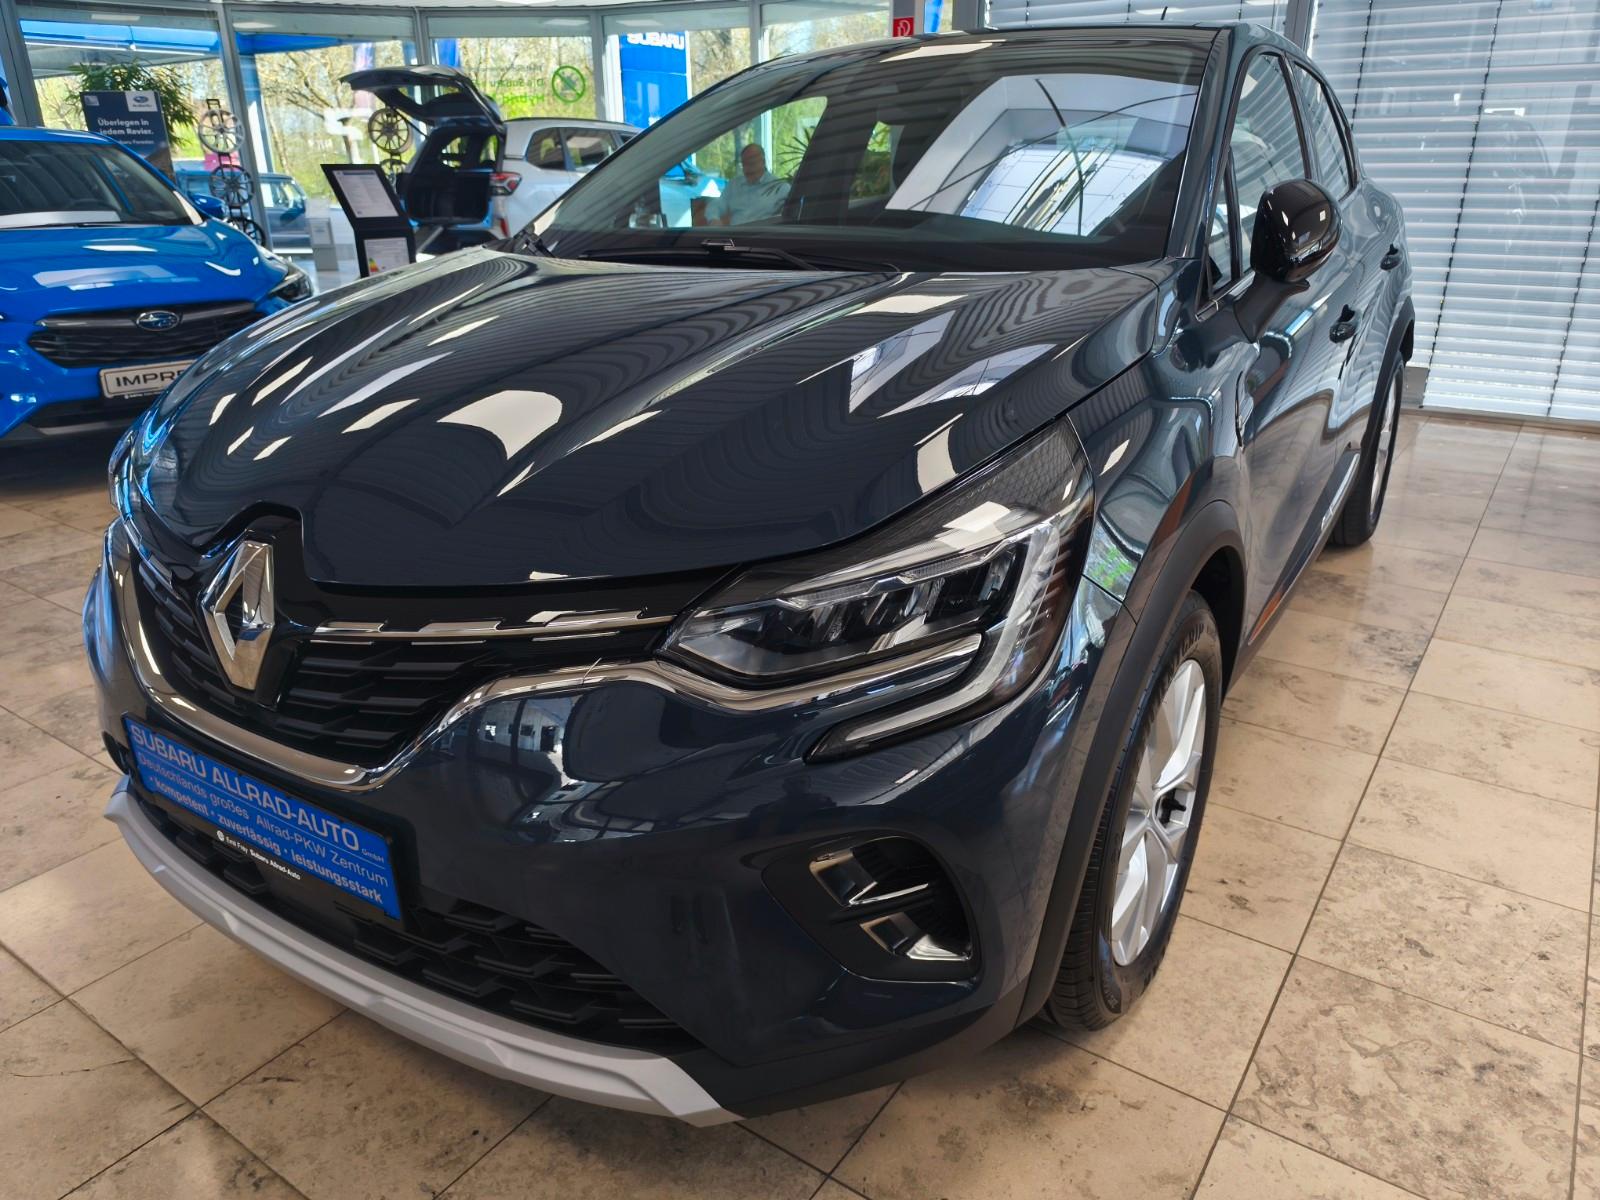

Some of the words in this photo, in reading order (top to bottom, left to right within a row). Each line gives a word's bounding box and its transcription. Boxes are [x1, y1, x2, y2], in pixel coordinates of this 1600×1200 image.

[97, 117, 139, 127] Überlegen
[141, 118, 149, 126] in
[130, 723, 207, 779] SUBARU
[212, 766, 360, 852] ALLRAD-AUTO
[138, 751, 208, 799] Deutschlands
[209, 792, 250, 820] großes
[256, 814, 327, 858] Allrad-PKW
[330, 849, 389, 888] Zentrum
[155, 776, 209, 817] kompetent
[217, 814, 282, 857] zuverlässig
[291, 848, 384, 905] leistungsstark
